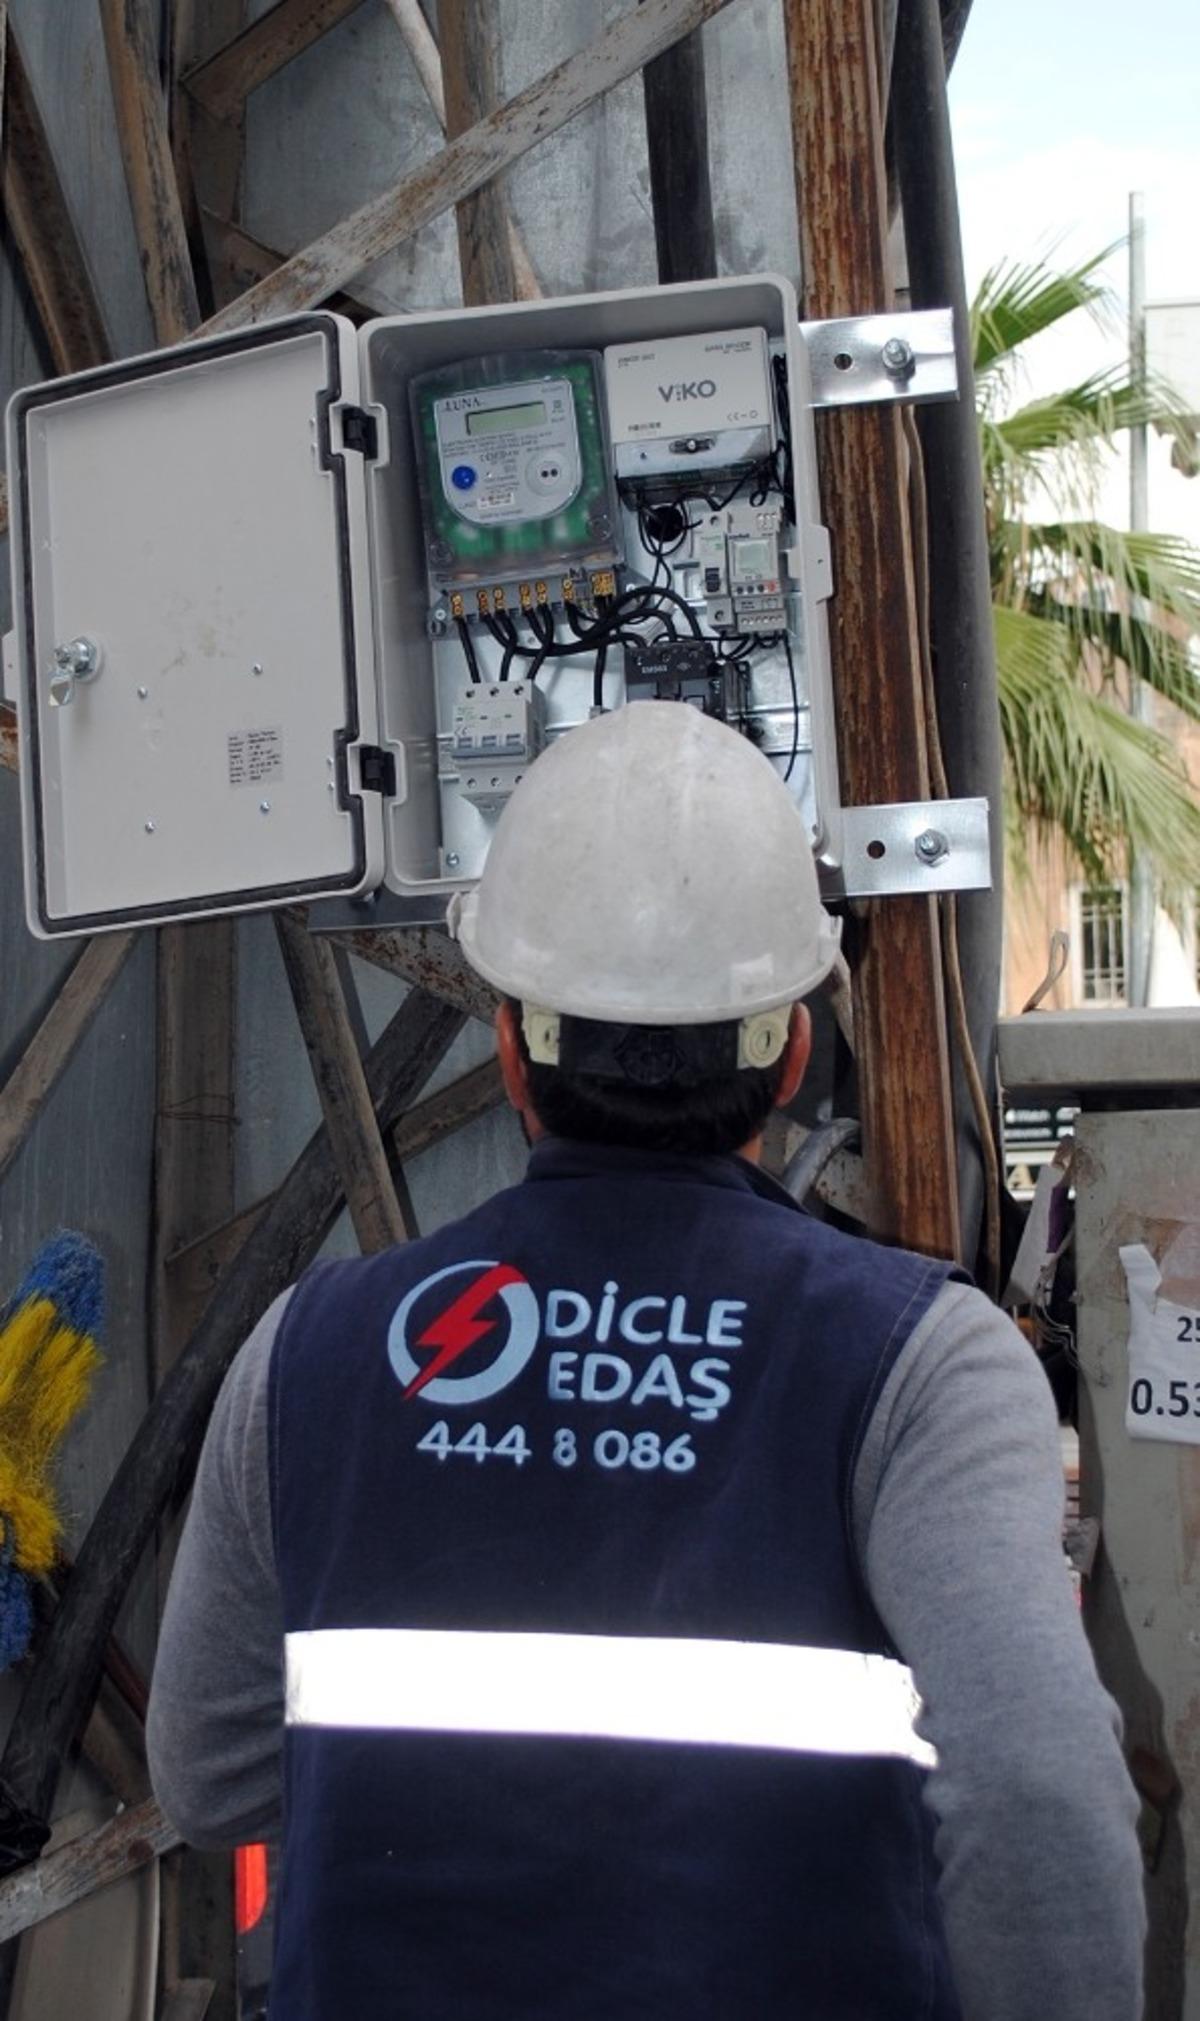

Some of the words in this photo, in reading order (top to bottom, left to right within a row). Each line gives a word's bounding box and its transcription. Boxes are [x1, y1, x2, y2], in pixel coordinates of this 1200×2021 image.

[545, 1281, 748, 1347] DİCLE
[548, 1351, 732, 1421] EDAŞ
[416, 1420, 532, 1465] 444
[552, 1427, 578, 1467] 8
[593, 1429, 697, 1473] 086
